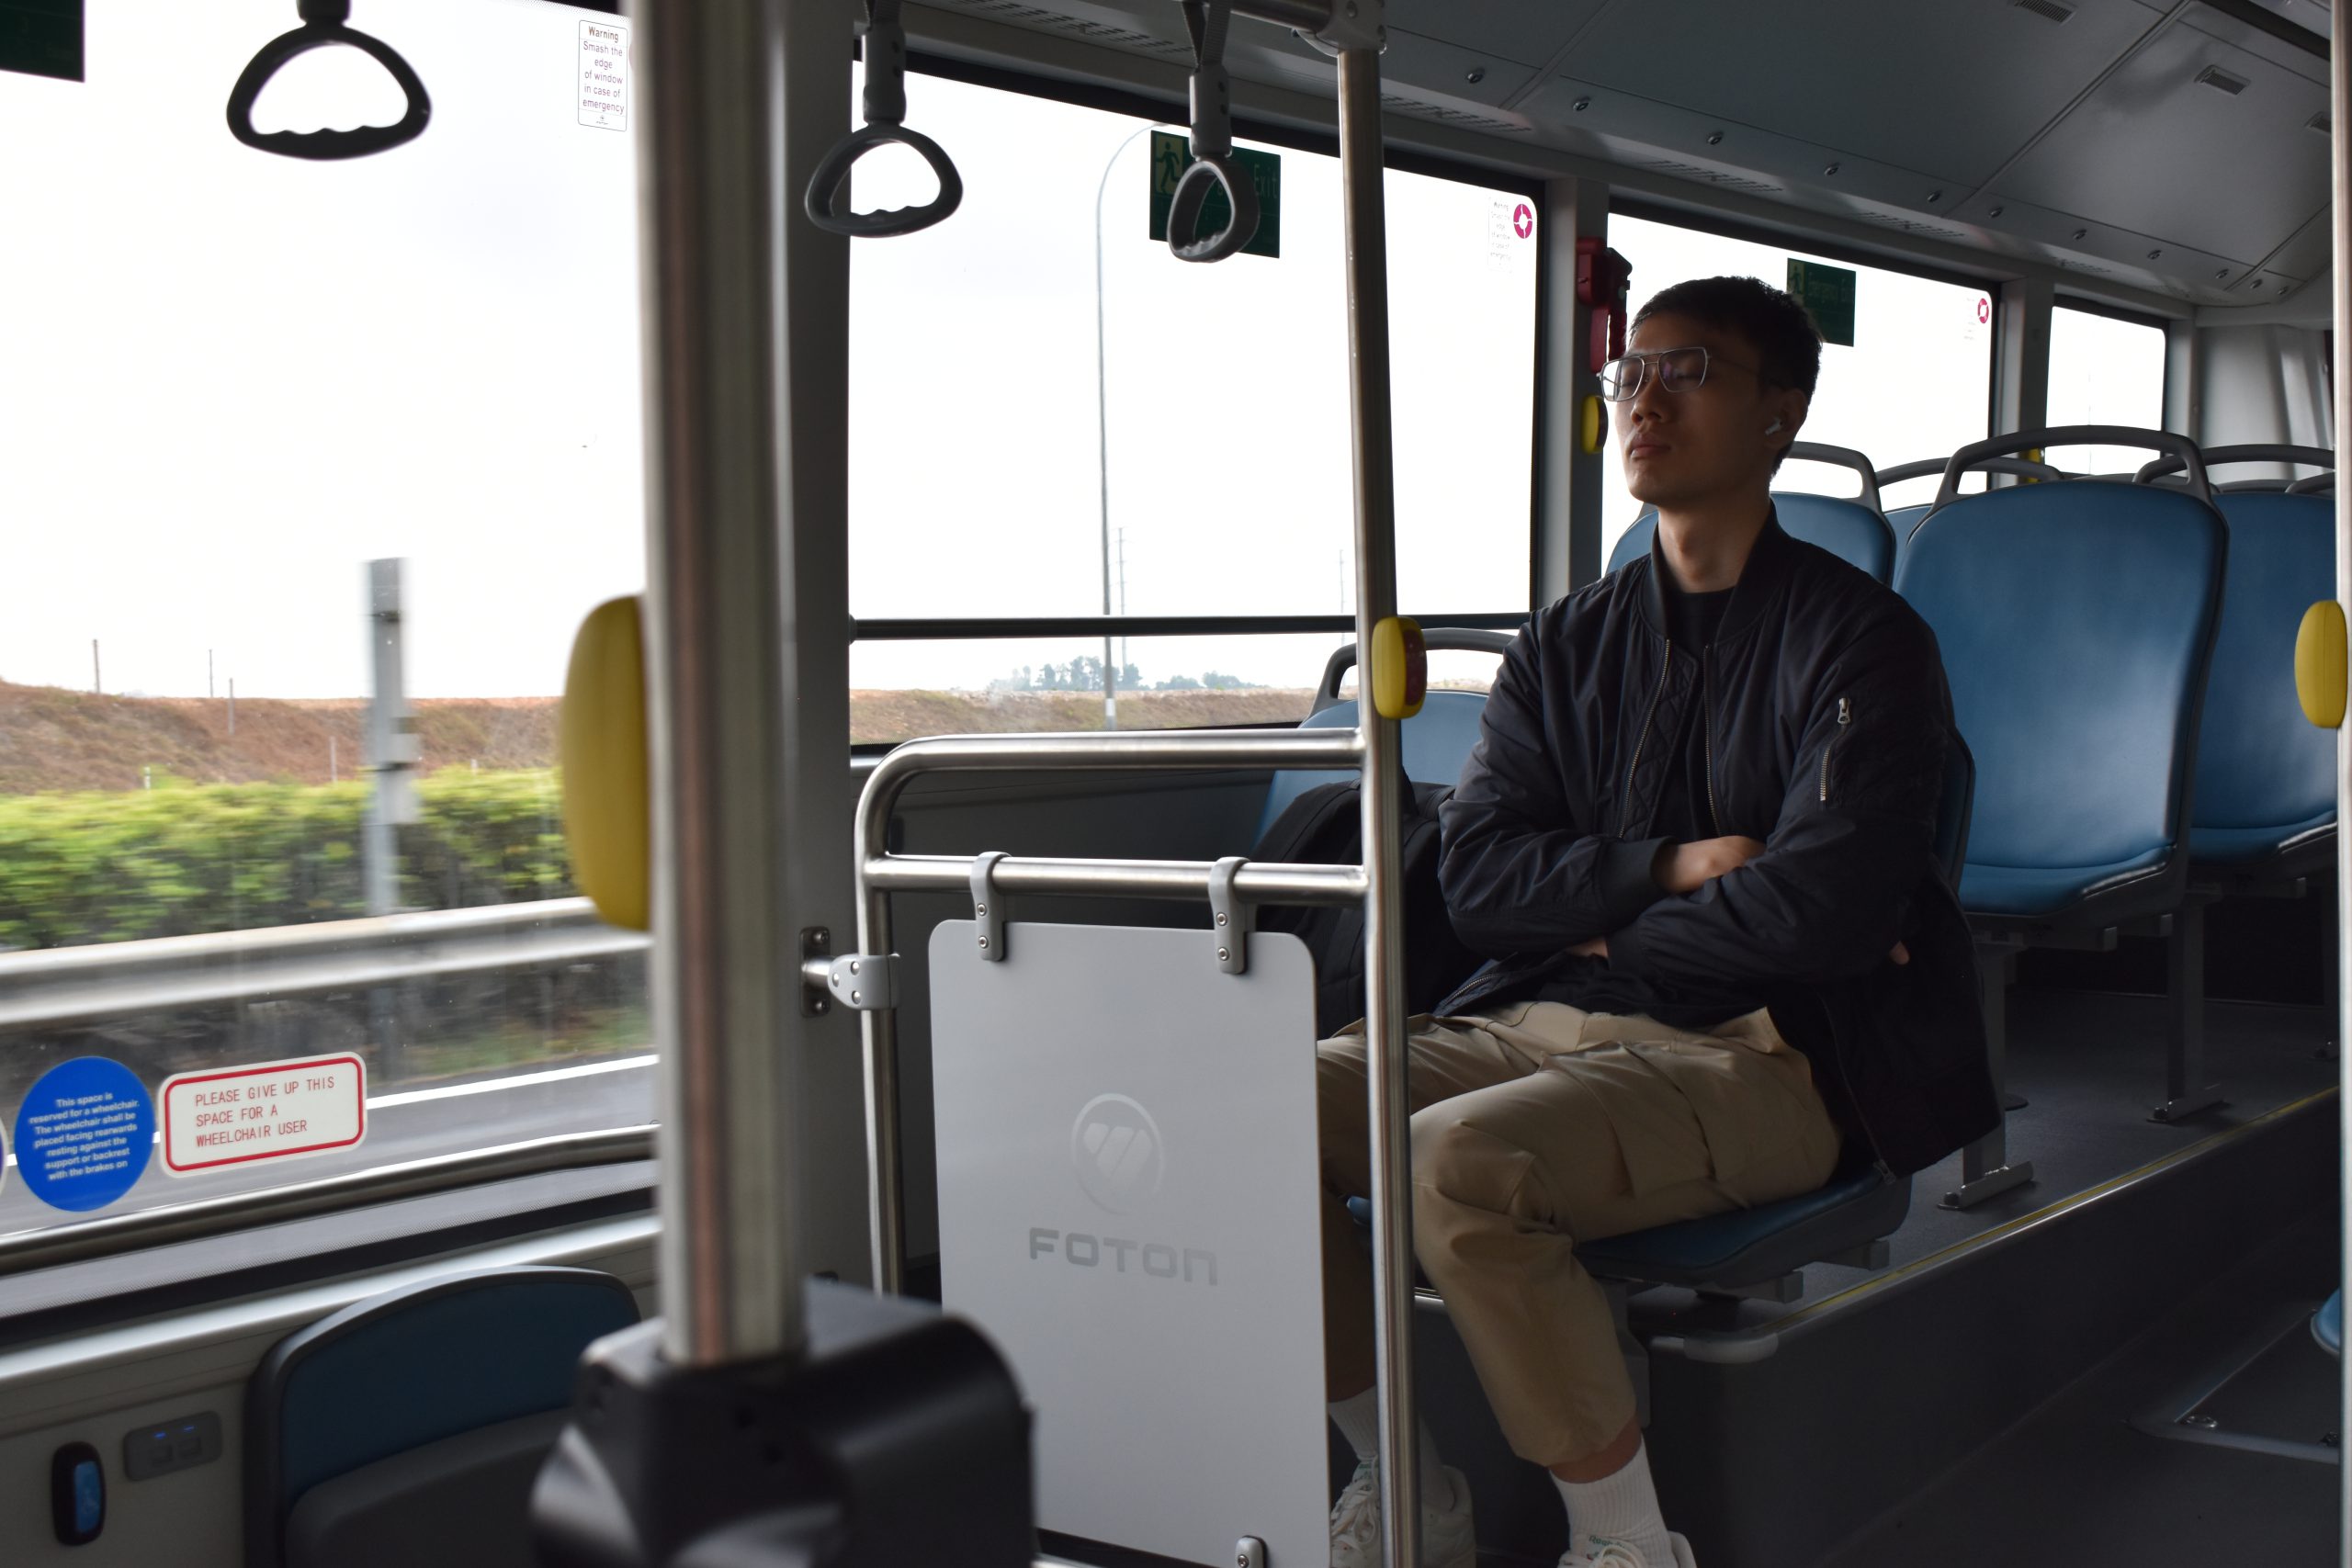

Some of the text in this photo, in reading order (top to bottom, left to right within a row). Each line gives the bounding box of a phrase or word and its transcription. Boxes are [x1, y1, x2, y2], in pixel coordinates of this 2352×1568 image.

[588, 25, 619, 43] Warning
[583, 40, 623, 57] Smash the
[594, 58, 613, 70] edge
[584, 70, 624, 85] of window
[584, 84, 621, 97] in case of
[582, 98, 625, 115] emergency
[56, 1092, 113, 1108] This space is
[195, 1076, 335, 1107] PLEASE GIVE UP THIS
[29, 1111, 68, 1123] reserved
[70, 1109, 83, 1117] for
[35, 1111, 136, 1135] The wheelchair shall be
[196, 1104, 278, 1127] SPACE FOR A
[34, 1122, 138, 1149] placed facing rearwards
[196, 1119, 308, 1147] WHEELCHAIR USER
[47, 1137, 127, 1157] resting against the
[44, 1147, 130, 1169] support or backrest
[48, 1160, 129, 1180] with the brakes on
[1029, 1226, 1217, 1286] FOTON
